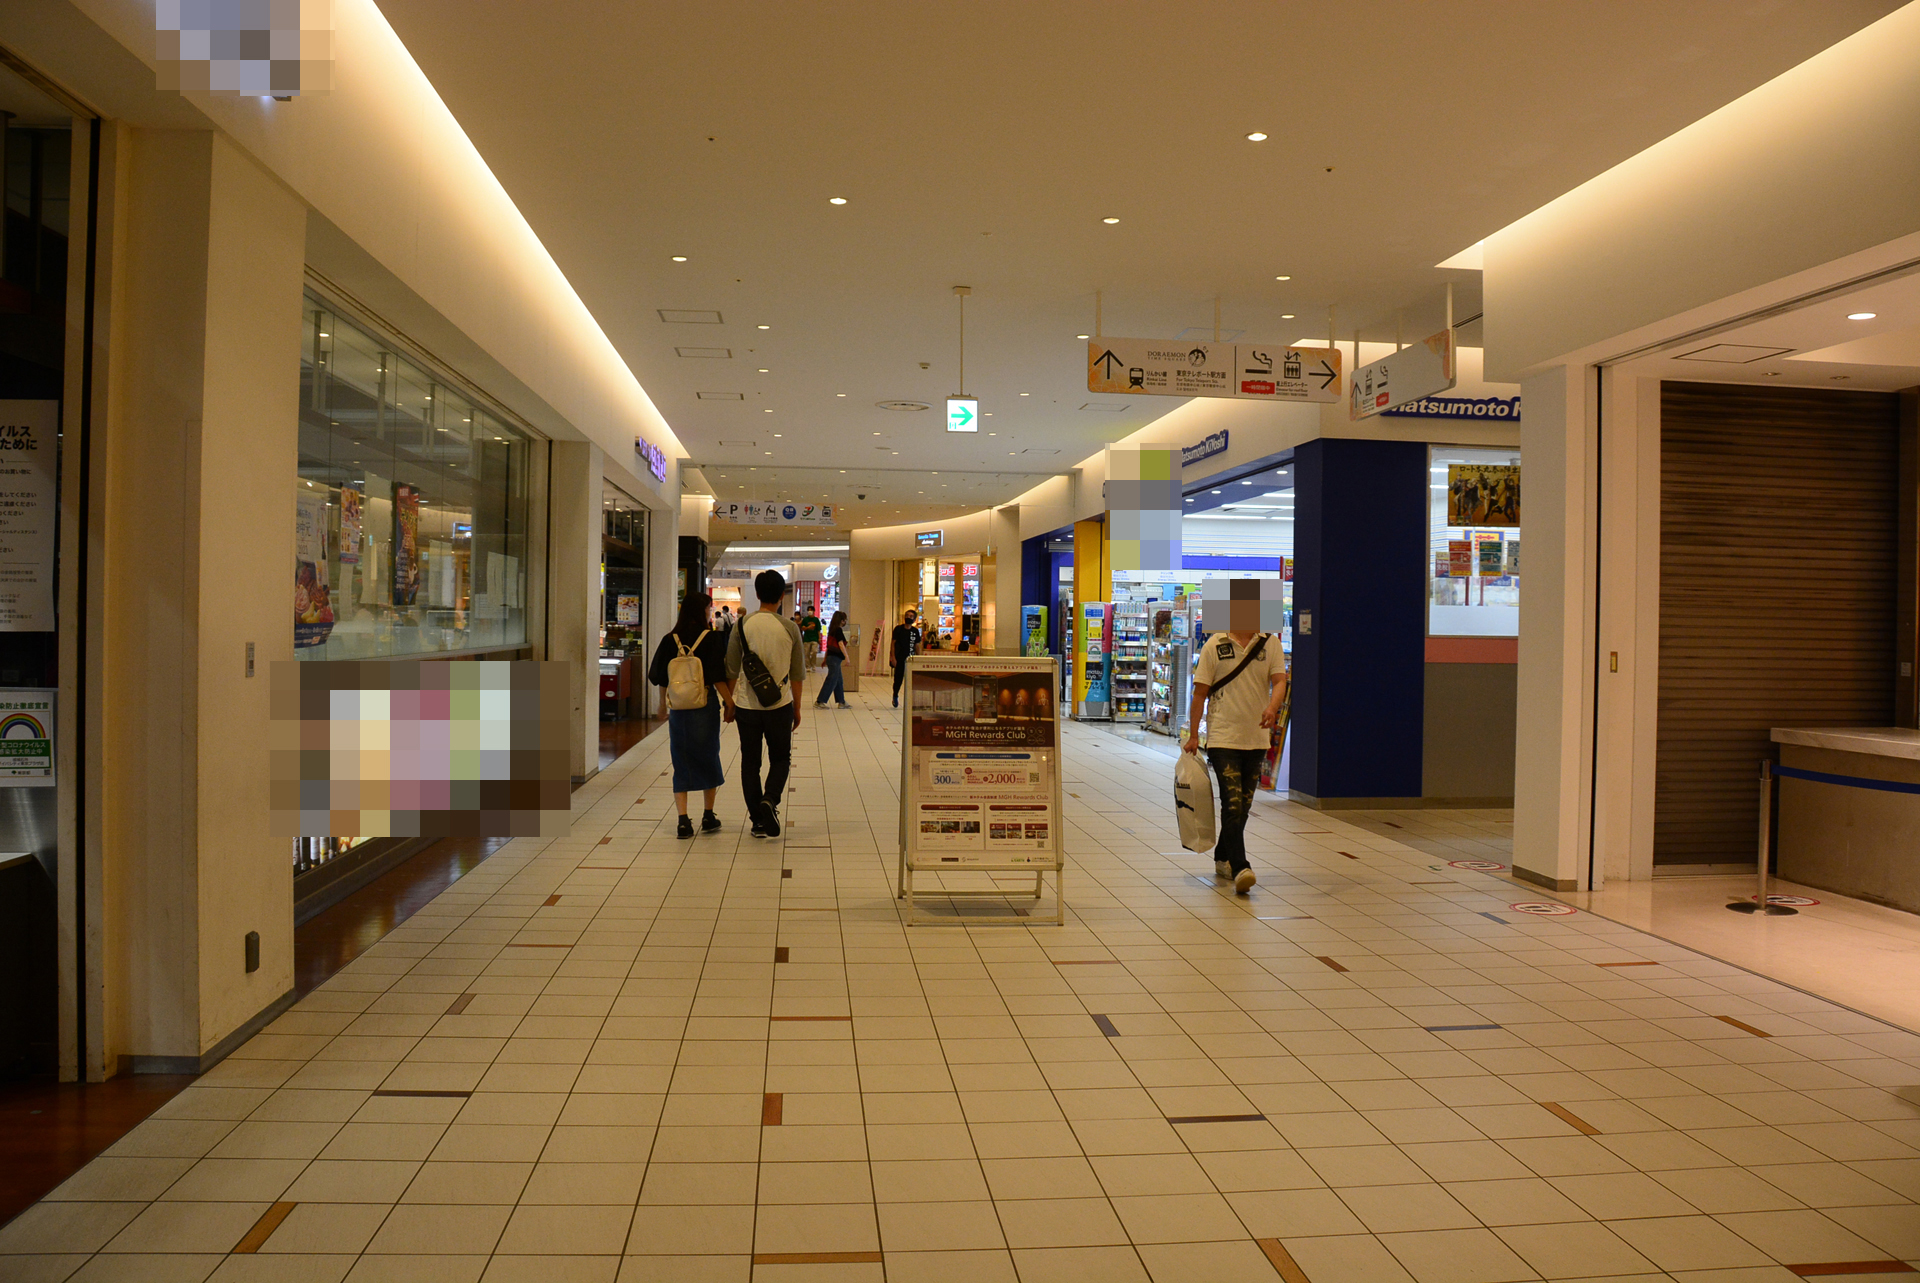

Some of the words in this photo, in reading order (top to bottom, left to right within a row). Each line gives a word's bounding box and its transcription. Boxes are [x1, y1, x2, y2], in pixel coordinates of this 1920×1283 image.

[1176, 370, 1226, 379] 東京テレポート駅方面
[0, 438, 38, 450] ために
[730, 504, 738, 515] P
[970, 731, 1005, 739] Rewards
[1007, 731, 1026, 739] Club
[934, 776, 951, 785] 300
[988, 774, 1016, 784] 2,000
